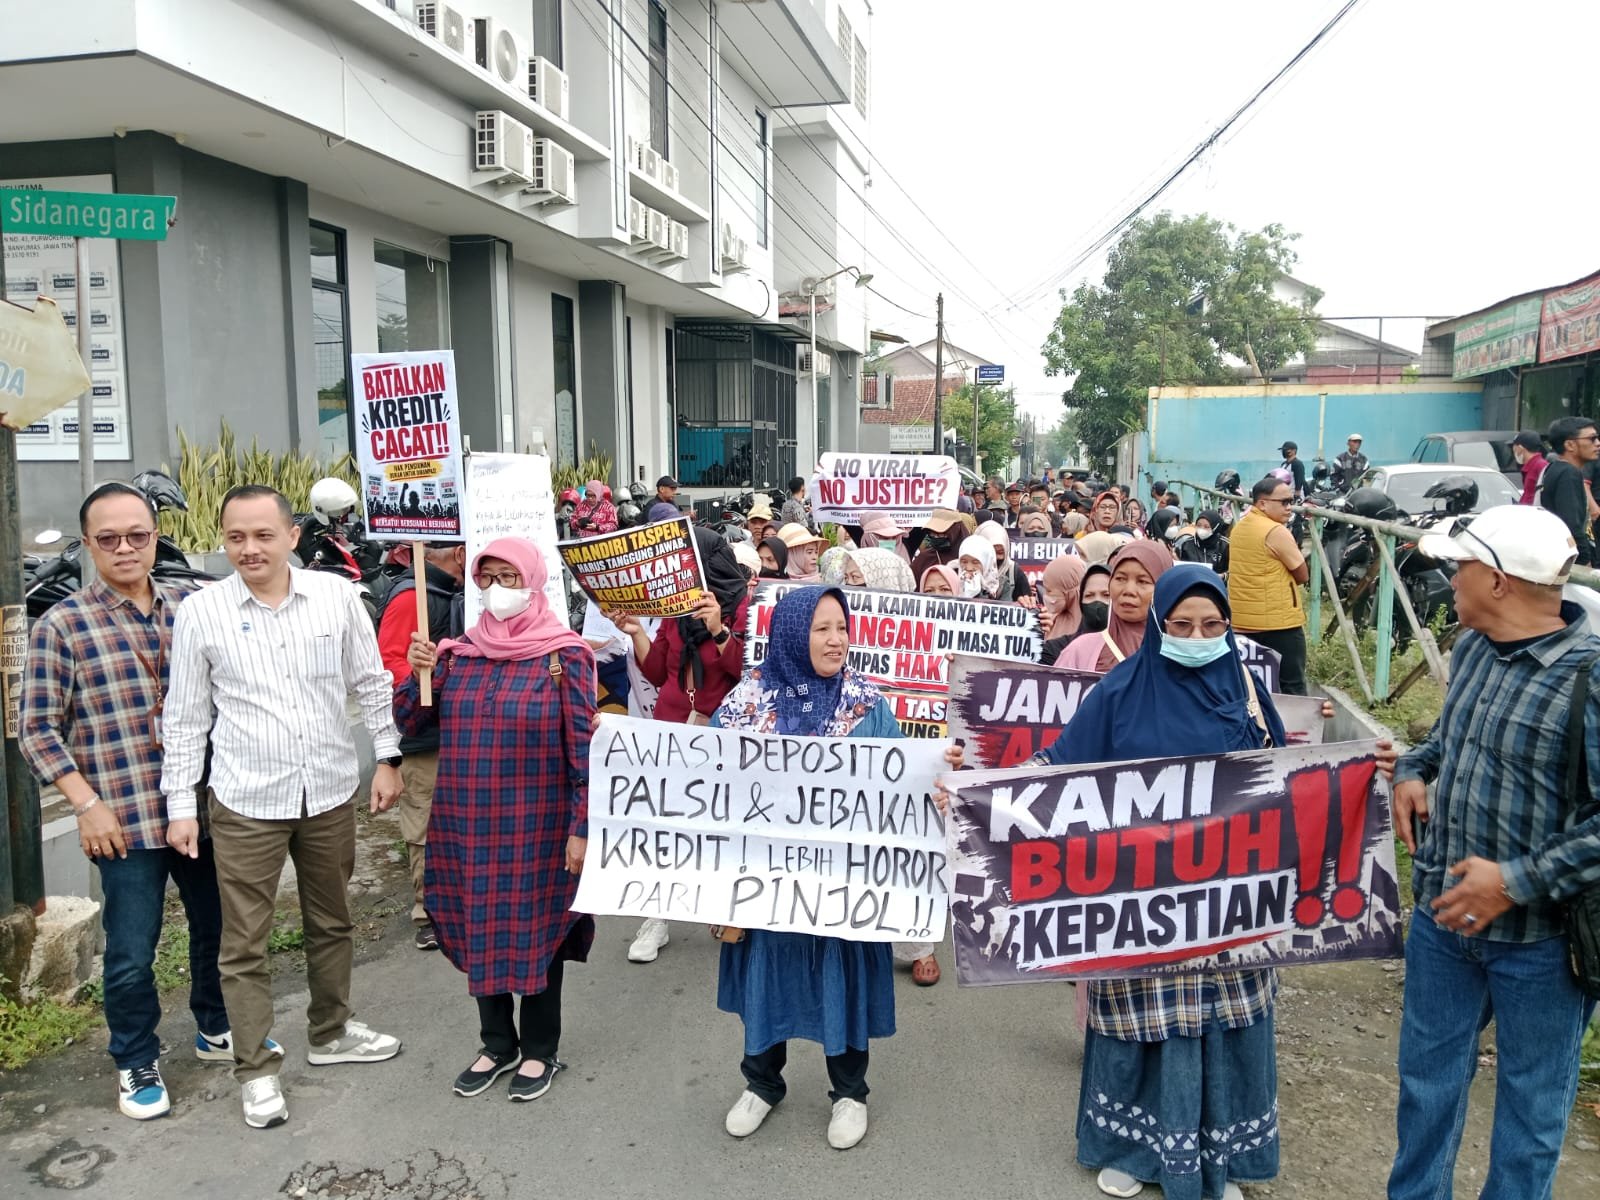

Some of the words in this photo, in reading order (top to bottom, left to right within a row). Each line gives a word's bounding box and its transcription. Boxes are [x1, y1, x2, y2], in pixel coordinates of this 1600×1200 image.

[10, 195, 155, 236] Sidanegara
[362, 362, 445, 401] BATALKAN
[368, 392, 443, 430] KREDIT
[370, 422, 449, 461] CACAT!!
[833, 458, 862, 478] NO
[868, 459, 926, 480] VIRAL,
[818, 478, 846, 505] NO
[851, 478, 948, 506] JUSTICE?
[568, 536, 628, 565] MANDIRI
[629, 521, 681, 549] TASPEN
[577, 560, 606, 574] HARUS
[607, 548, 654, 570] TANGGUNG
[655, 538, 687, 556] JAWAB,
[585, 554, 682, 589] BATALKAN
[594, 584, 645, 601] KREDIT
[646, 575, 674, 591] ORANG
[676, 569, 693, 581] TUA
[634, 600, 662, 610] HANYA
[663, 592, 690, 607] JANJI
[648, 584, 677, 601] KAMI
[663, 604, 685, 614] SAJA
[878, 595, 921, 617] KAMI
[925, 600, 976, 623] HANYA
[979, 604, 1027, 628] PERLU
[937, 629, 954, 650] DI
[957, 632, 1001, 656] MASA
[1003, 635, 1036, 659] TUA,
[895, 652, 943, 681] HAK
[979, 678, 1097, 724] JAN
[604, 730, 724, 772] AWAS!
[738, 735, 906, 783] DEPOSITO
[609, 775, 730, 823] PALSU
[743, 781, 775, 824] &
[785, 785, 946, 838] JEBAKAN
[989, 760, 1217, 843] KAMI
[768, 844, 833, 877] LEBIH
[845, 843, 949, 895] HOROR
[1010, 808, 1282, 904] BUTUH
[618, 880, 701, 915] DARI
[1022, 875, 1291, 963] KEPASTIAN
